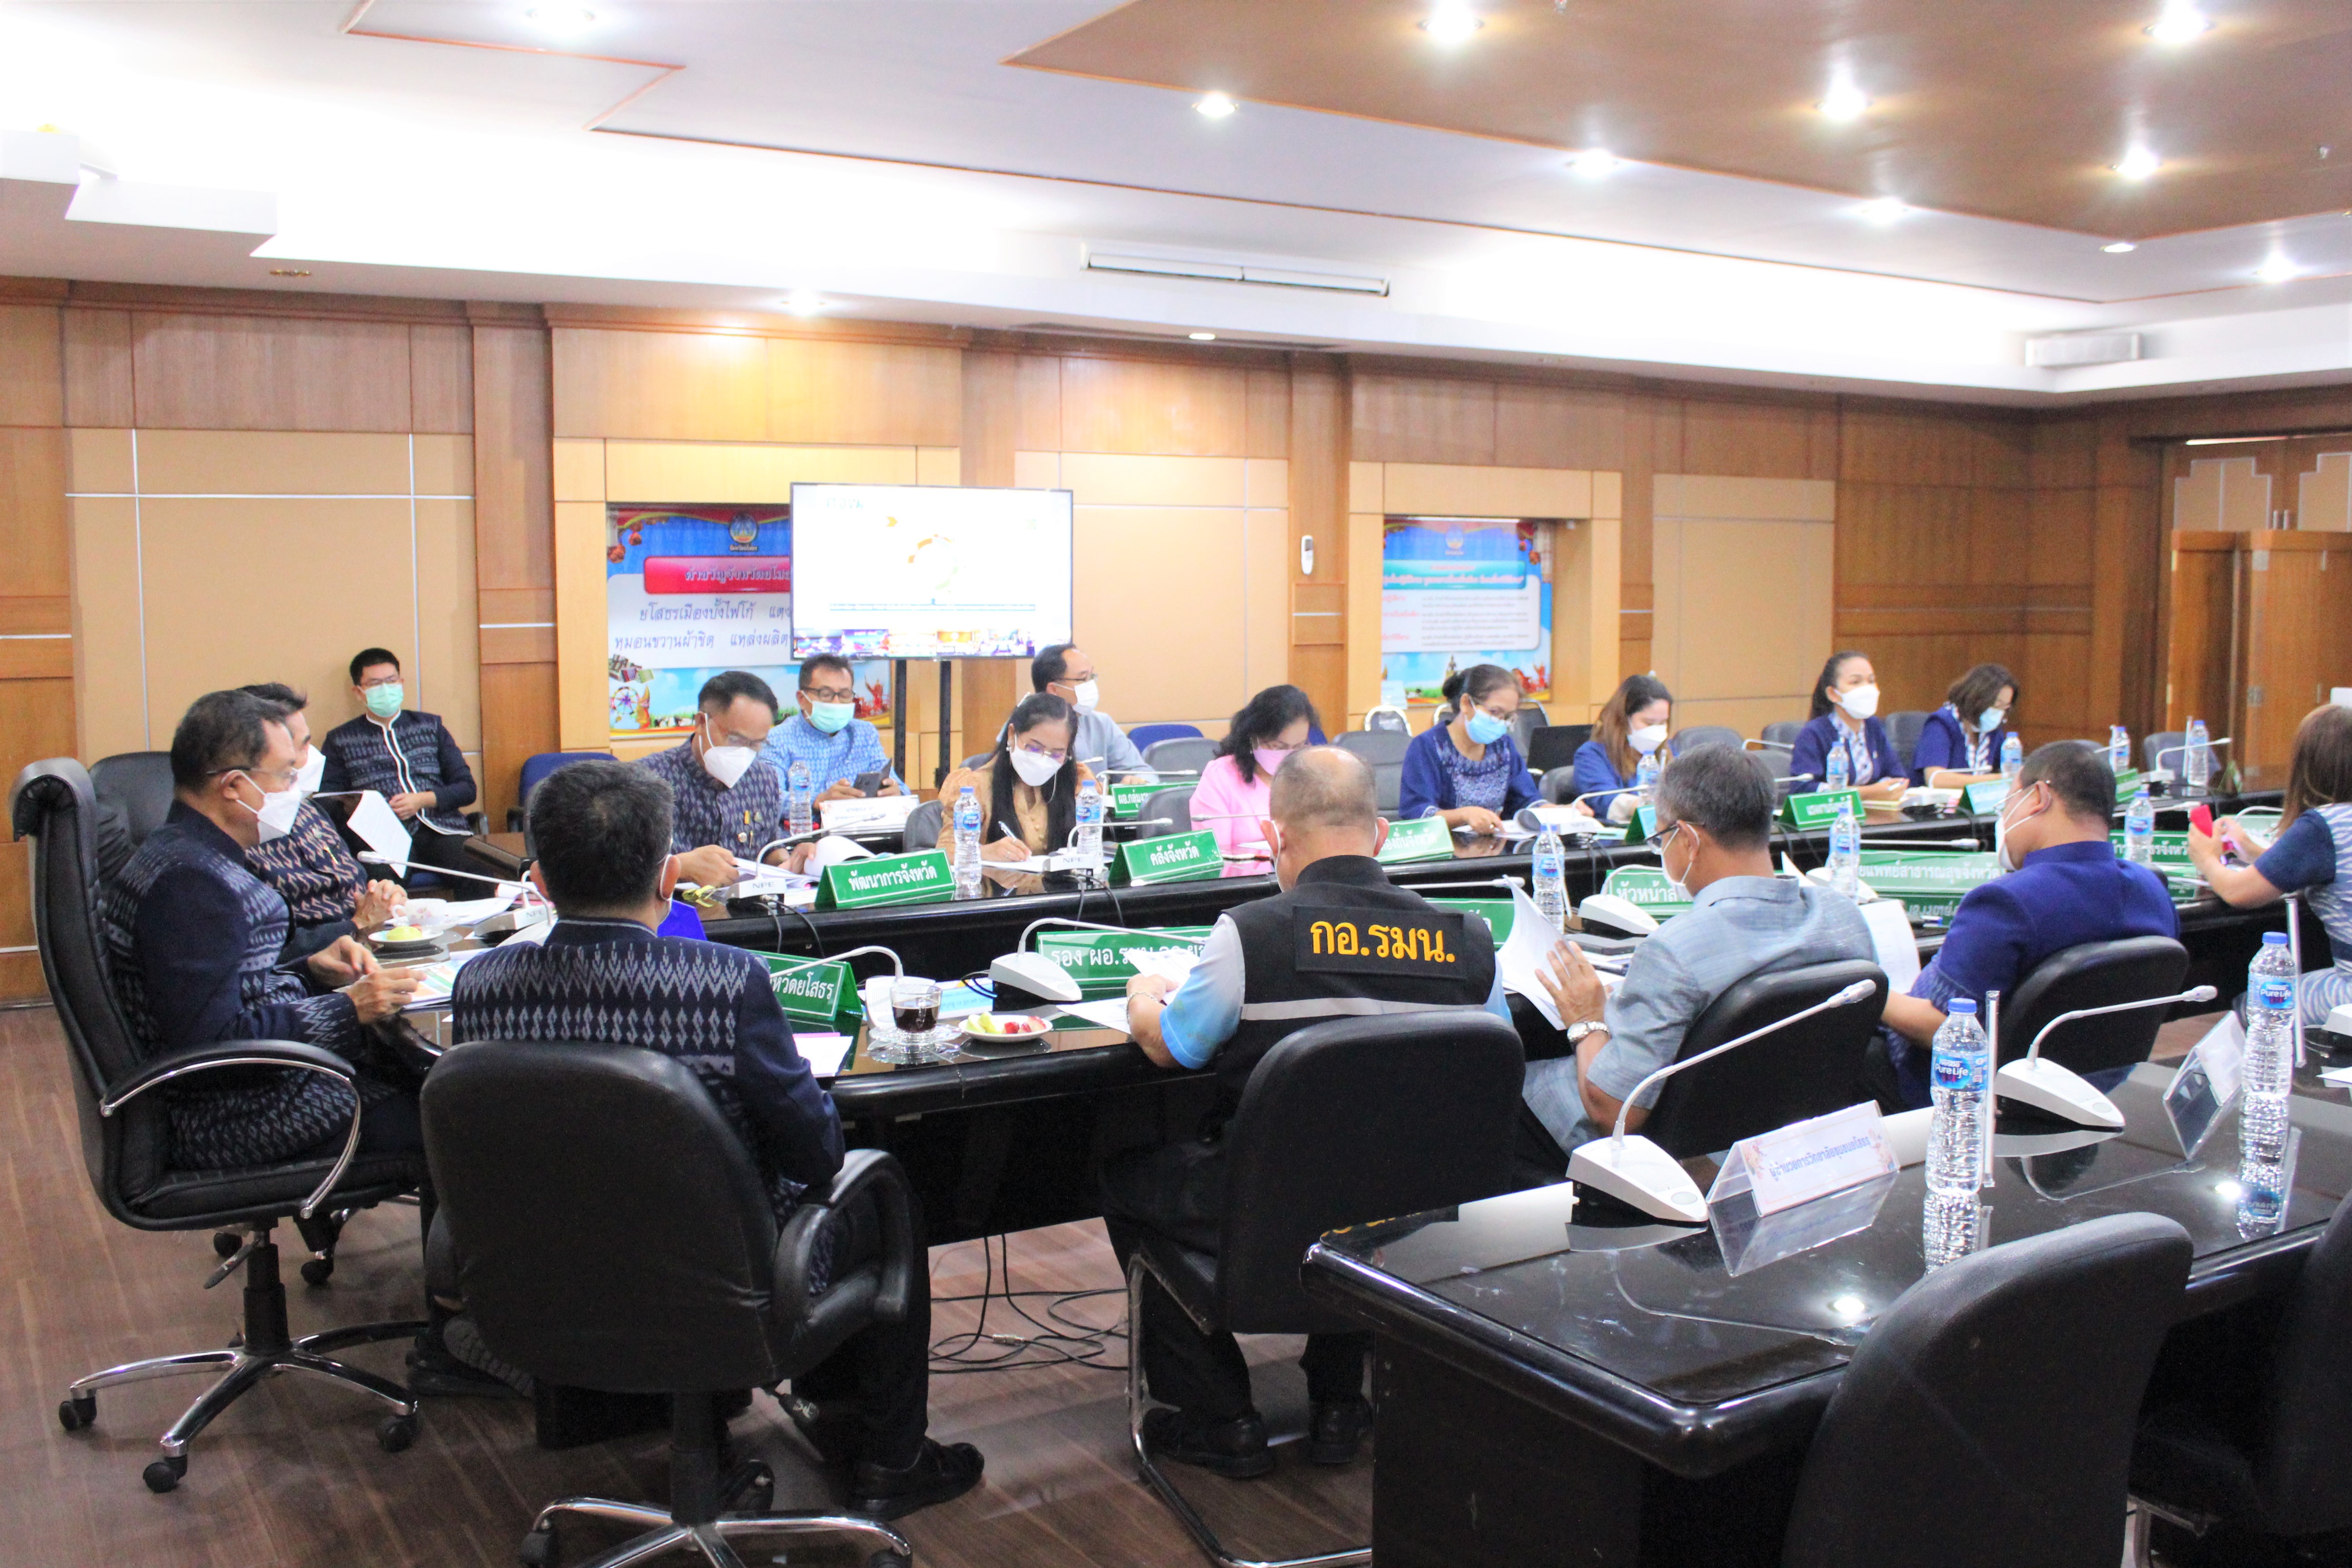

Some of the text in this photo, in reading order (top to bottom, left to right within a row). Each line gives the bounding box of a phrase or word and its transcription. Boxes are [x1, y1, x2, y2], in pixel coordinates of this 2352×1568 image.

[615, 628, 790, 651] หมอนขวานผ้าขิด แหล่งผลิต
[1150, 840, 1200, 866] คลังจังหวัด
[848, 859, 938, 892] พัฒนาการจังหวัด
[526, 909, 545, 918] NPE
[1309, 921, 1455, 963] กอ.รมน.
[1051, 949, 1083, 967] รอง
